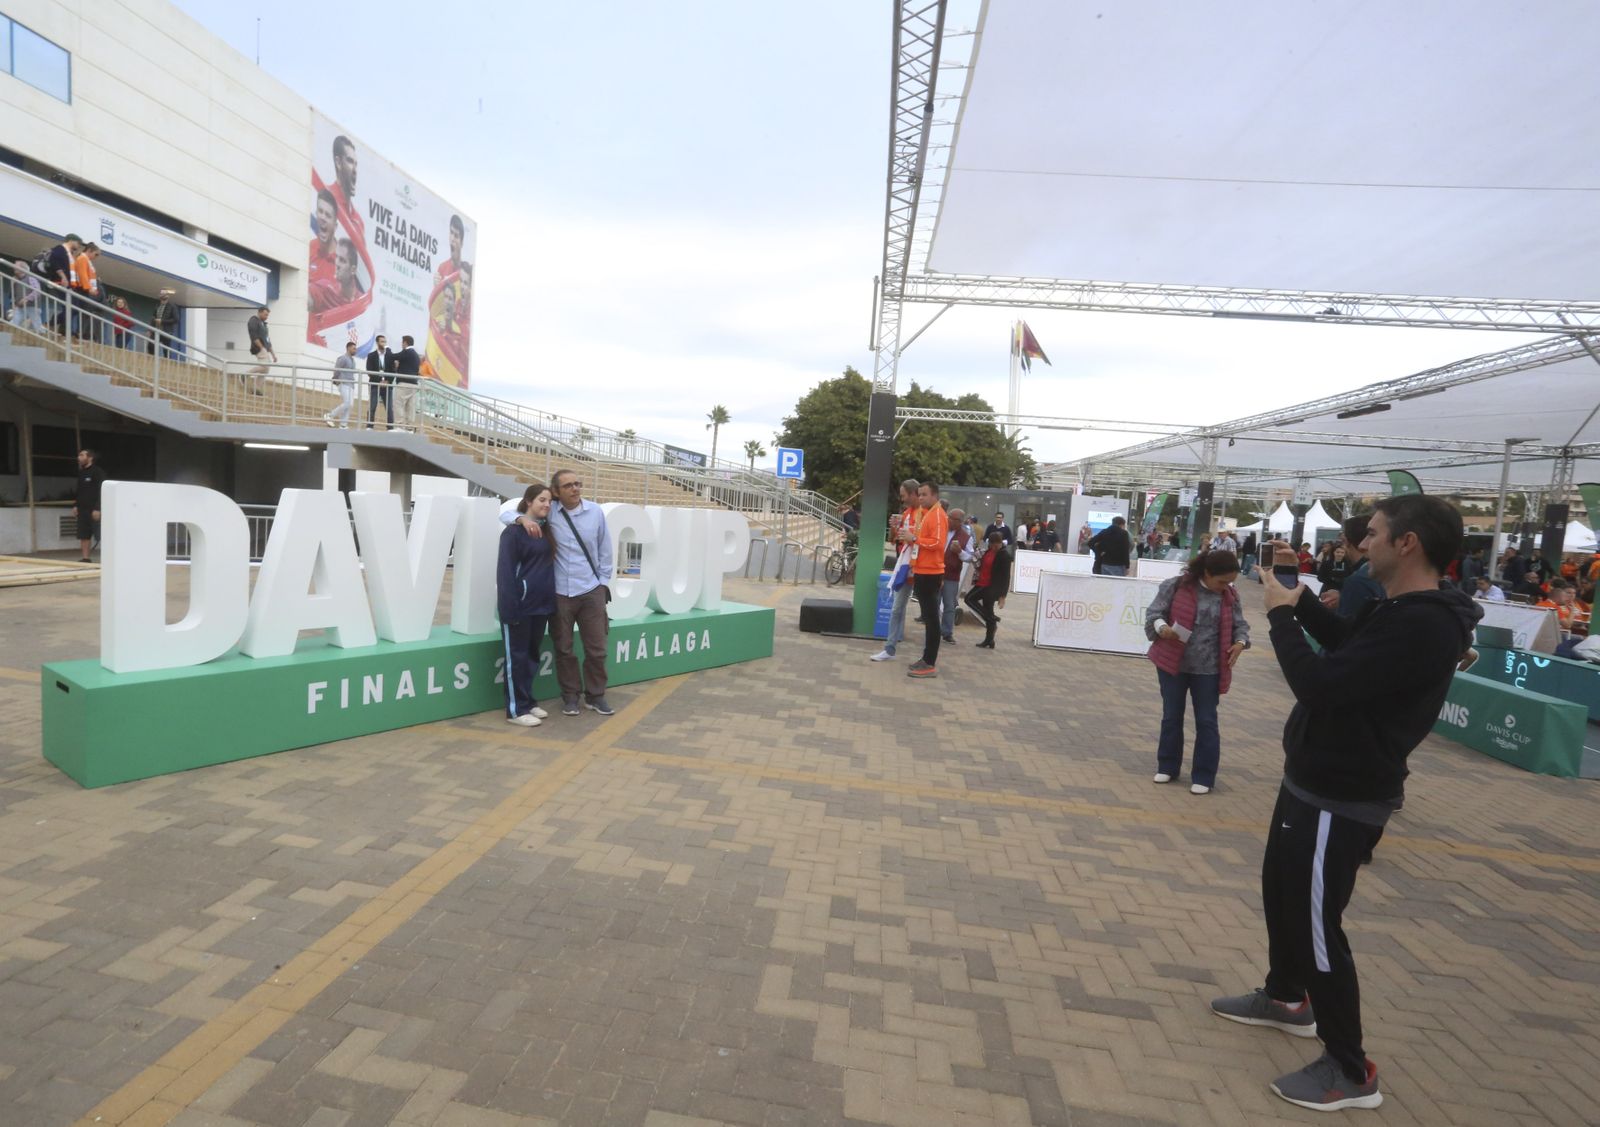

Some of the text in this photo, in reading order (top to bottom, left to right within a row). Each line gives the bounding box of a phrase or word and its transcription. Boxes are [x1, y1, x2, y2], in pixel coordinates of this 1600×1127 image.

[368, 198, 438, 255] VIVE LA DAVIS
[374, 226, 432, 274] EN MÁLAGA
[211, 260, 258, 284] DAVIS CUP
[782, 452, 798, 475] P
[307, 662, 470, 714] FINALS
[616, 629, 712, 663] MÁLAGA
[1486, 722, 1531, 745] DAVIS CUP
